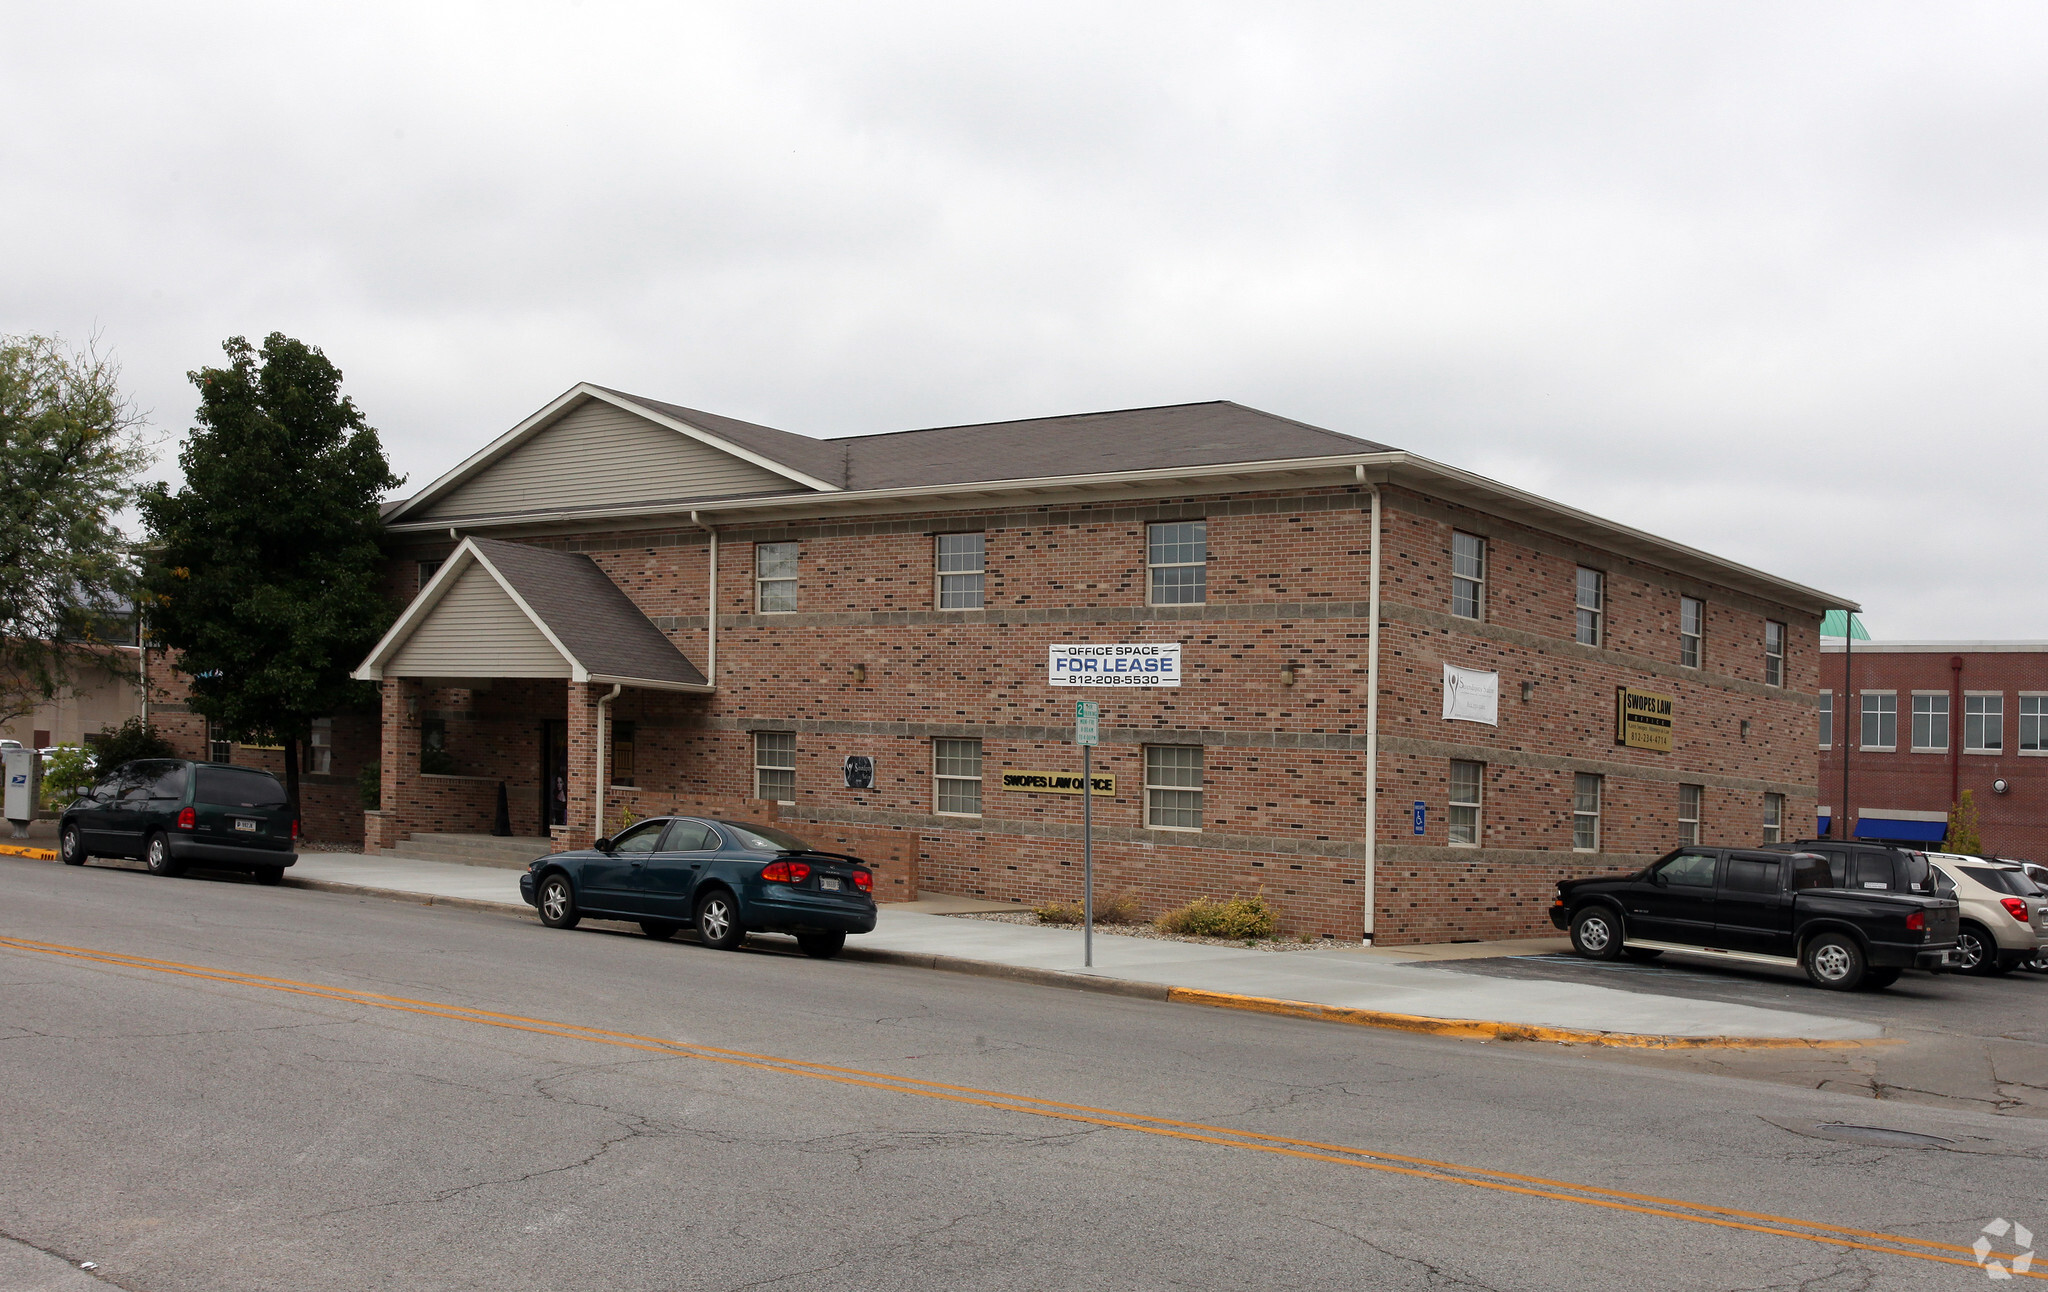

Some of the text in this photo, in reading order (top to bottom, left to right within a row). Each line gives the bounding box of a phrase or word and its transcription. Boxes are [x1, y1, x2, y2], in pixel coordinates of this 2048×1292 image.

[1068, 646, 1159, 655] OFFICE SPACE
[1056, 658, 1173, 672] FOR LEASE
[1069, 675, 1159, 684] 812-208-5530
[1078, 704, 1083, 715] 2
[1628, 694, 1671, 715] SWOPES LAW
[1634, 715, 1665, 726] OFFICE
[1631, 732, 1667, 745] 812-234-4714
[1003, 775, 1048, 788] SWOPES
[1048, 776, 1072, 789] LAW
